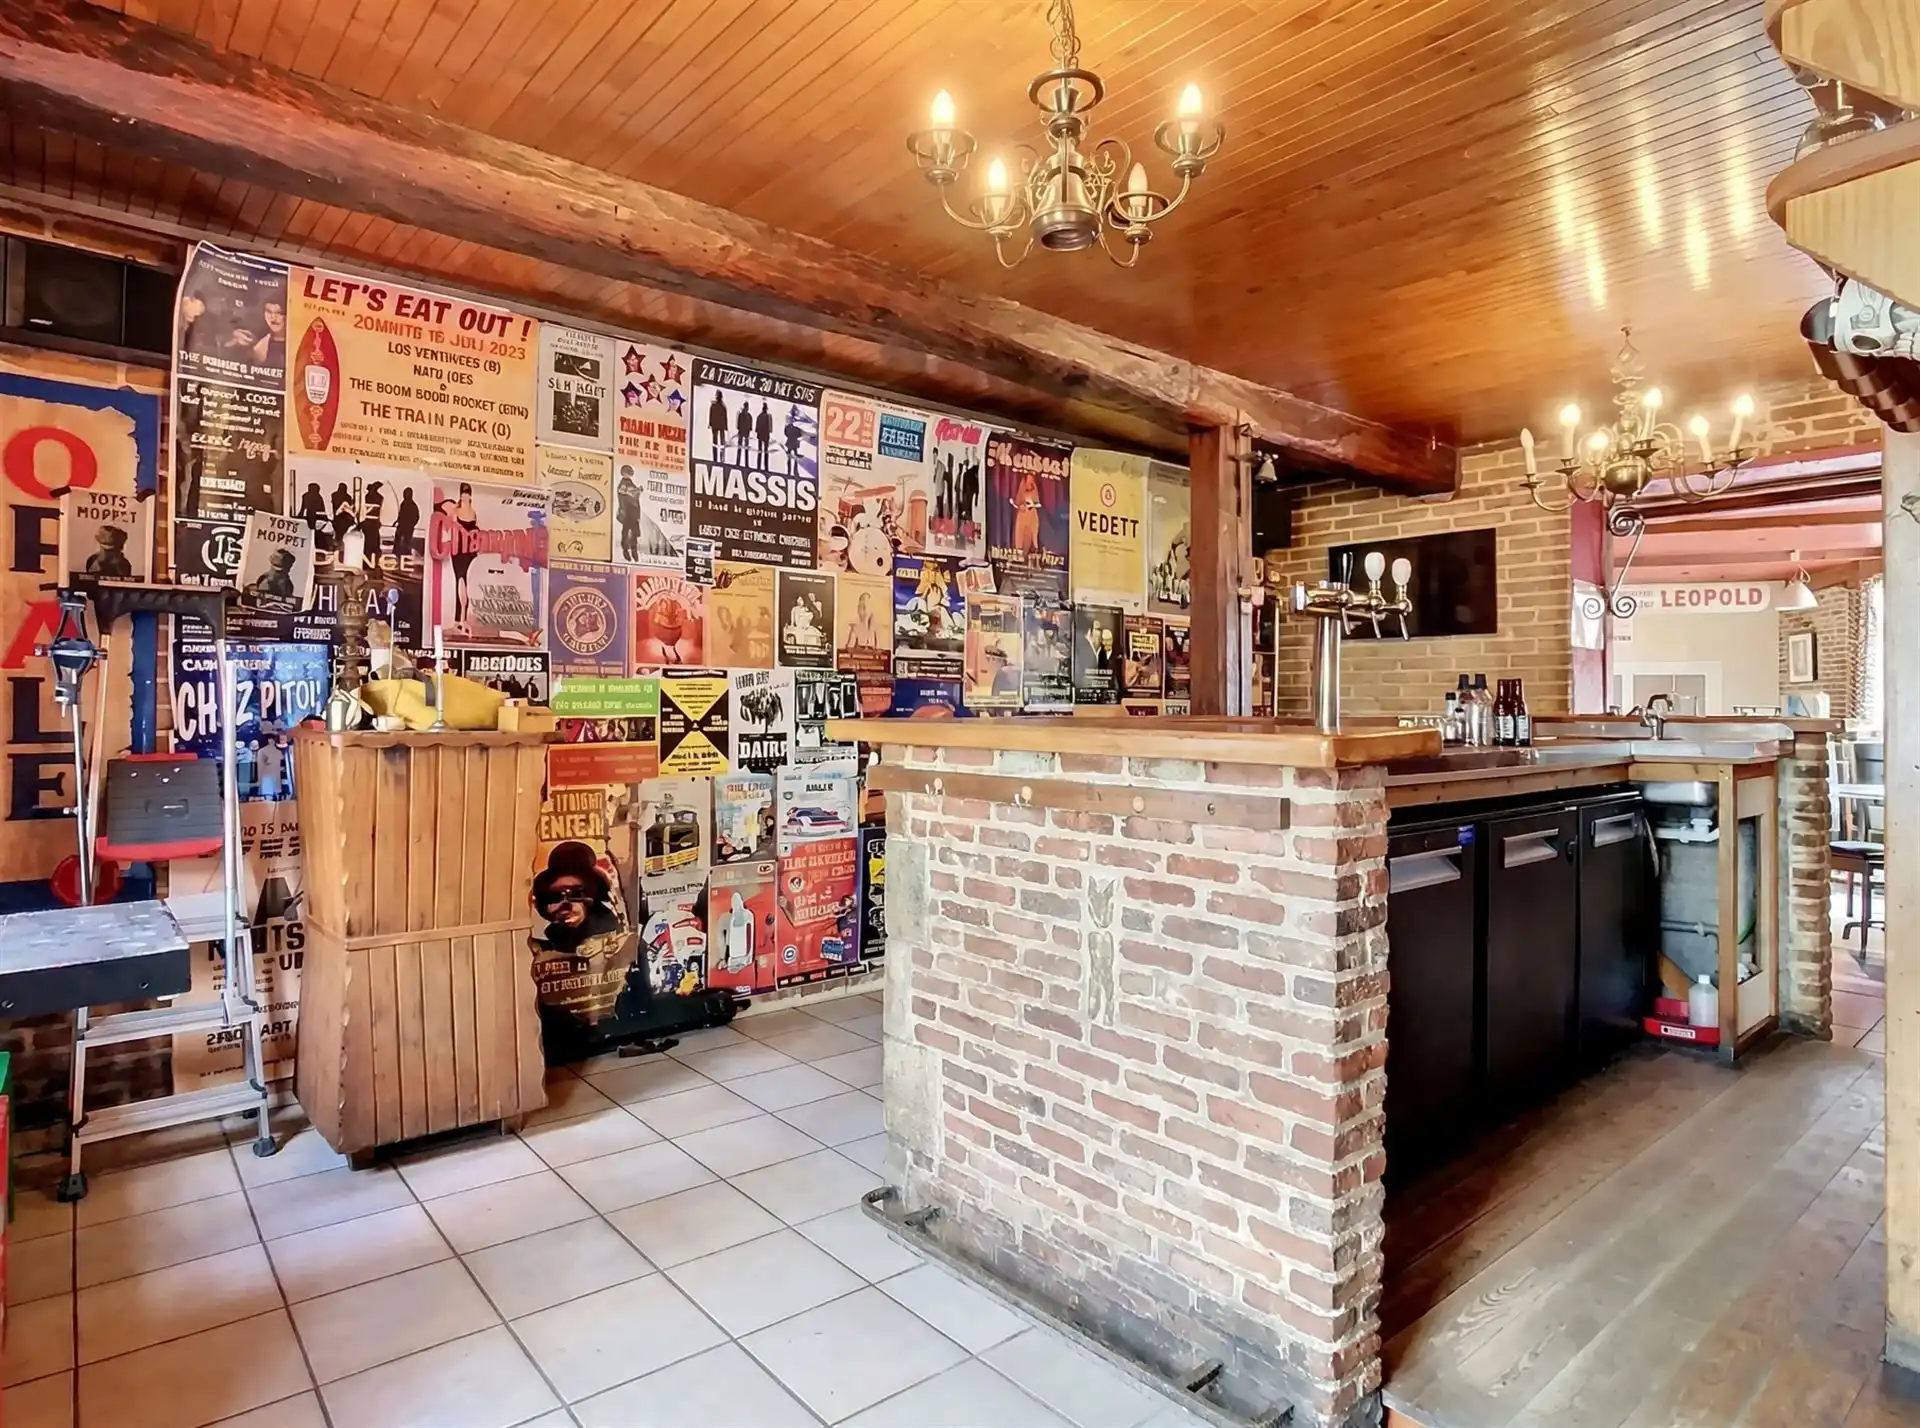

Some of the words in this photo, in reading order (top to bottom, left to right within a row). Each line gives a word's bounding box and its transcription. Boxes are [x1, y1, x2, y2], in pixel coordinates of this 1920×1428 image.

[303, 275, 387, 312] LET'S
[394, 294, 451, 324] EAT
[459, 308, 513, 338] OUT
[388, 341, 411, 356] LOS
[349, 377, 373, 392] THE
[376, 382, 412, 398] BOOM
[360, 400, 391, 419] THE
[394, 406, 445, 427] TRAIN
[450, 415, 488, 434] PACK
[826, 406, 862, 442] 22
[694, 463, 817, 512] MASSIS
[1077, 510, 1140, 539] VEDETT
[1660, 587, 1764, 608] LEOPOLD
